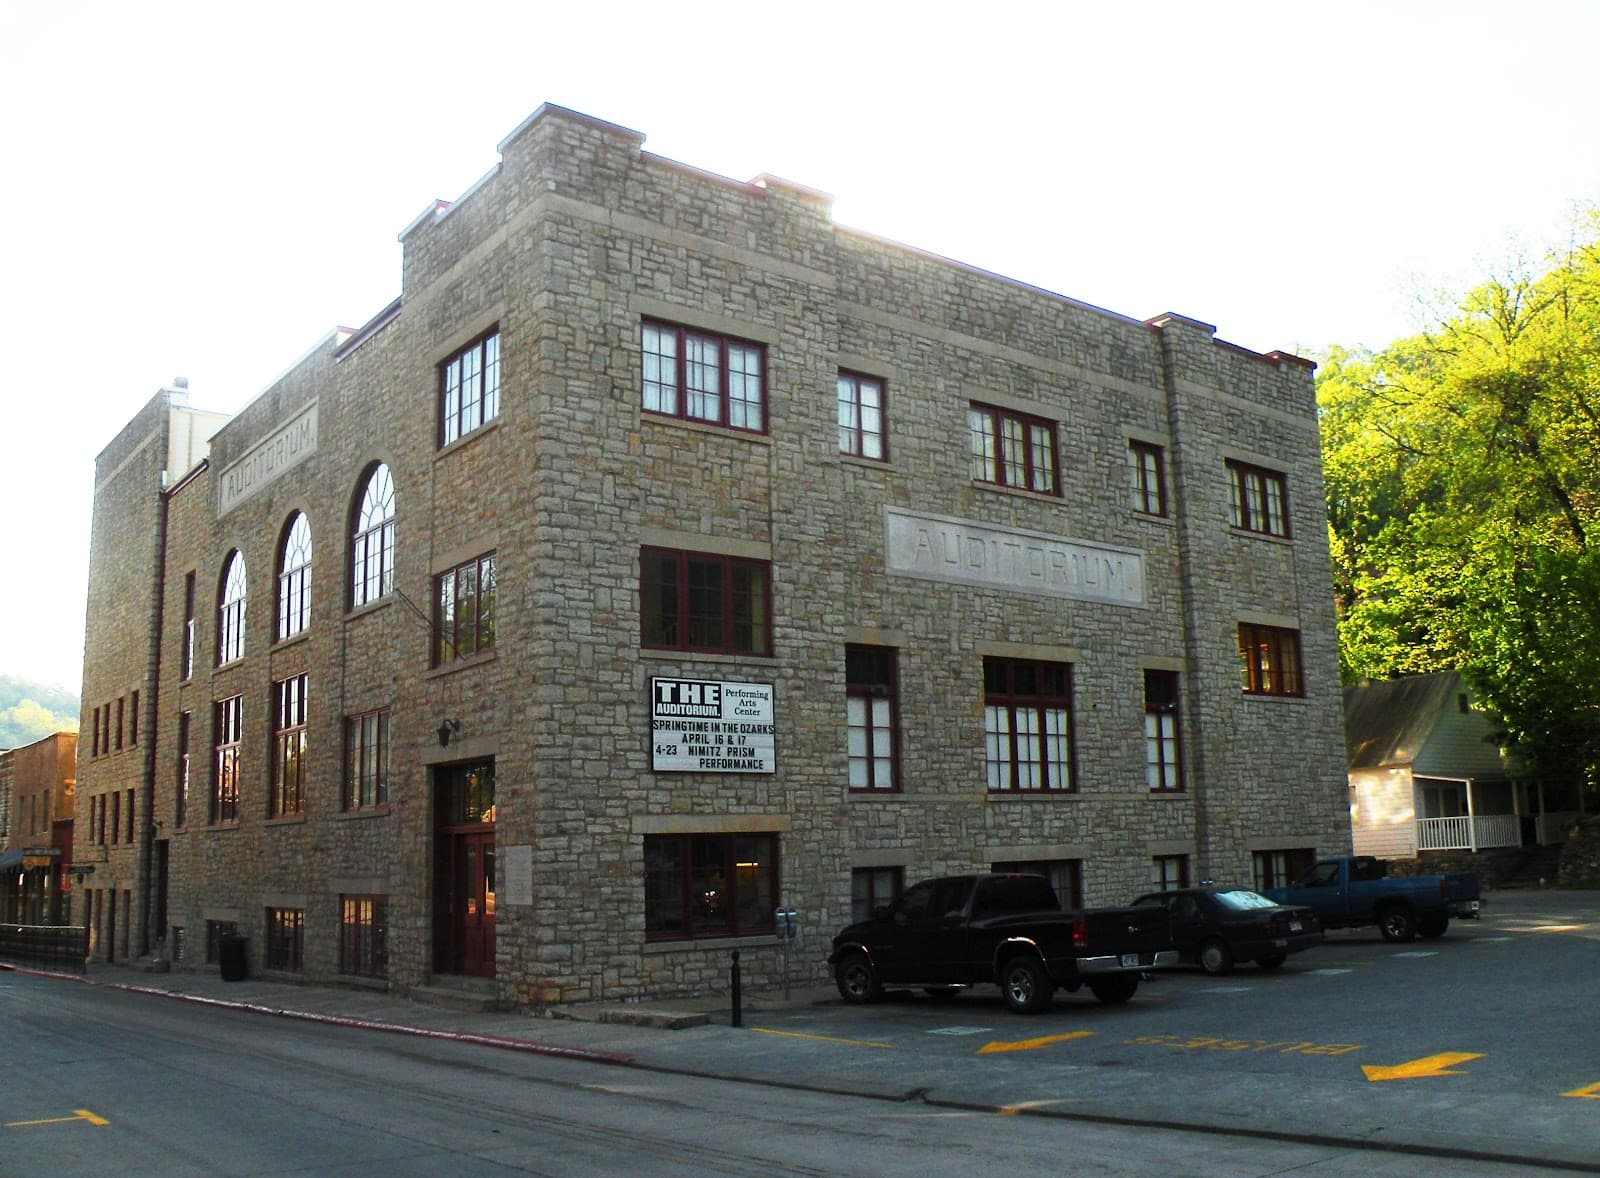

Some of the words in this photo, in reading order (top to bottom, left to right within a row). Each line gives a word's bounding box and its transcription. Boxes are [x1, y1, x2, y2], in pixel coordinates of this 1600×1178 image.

[656, 682, 720, 705] THE
[725, 689, 769, 701] Performing
[739, 699, 757, 707] Arts
[734, 707, 761, 716] Center
[653, 720, 709, 733] SPRINGTIME
[711, 722, 720, 733] IN
[722, 723, 739, 733] THE
[740, 724, 775, 735] OZARKS
[682, 733, 710, 744] APRIL
[715, 735, 724, 744] 16
[727, 735, 734, 745] &
[738, 736, 746, 745] 17
[656, 745, 678, 755] 4-23
[727, 747, 755, 758] PRISM
[699, 758, 764, 770] PERFORMANCE
